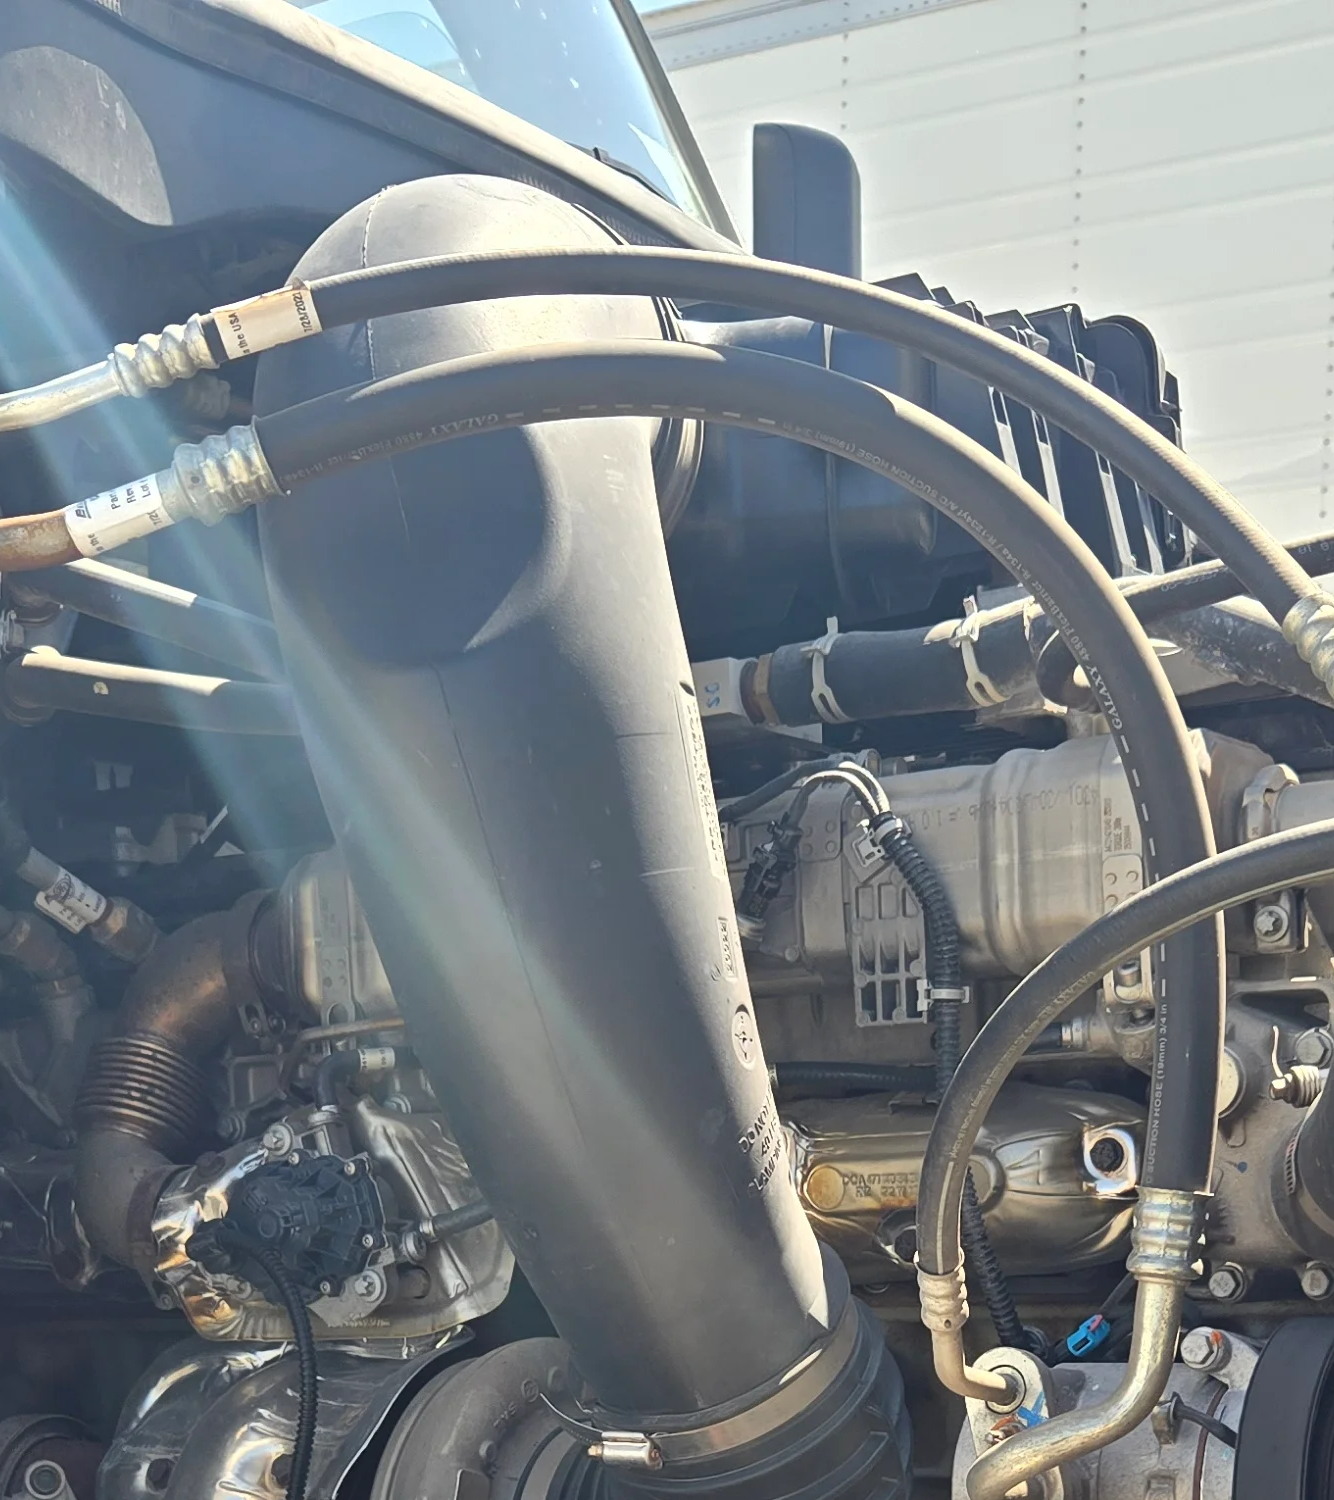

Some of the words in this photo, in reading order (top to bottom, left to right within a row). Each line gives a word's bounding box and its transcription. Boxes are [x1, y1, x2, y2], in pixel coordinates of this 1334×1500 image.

[228, 312, 242, 332] USA
[430, 413, 499, 438] GALAXY
[858, 448, 889, 469] HOSE
[891, 466, 940, 498] SUCTION
[939, 495, 958, 512] A/C
[1031, 580, 1071, 637] FlexBarrier
[1070, 635, 1090, 661] 4880
[1086, 664, 1123, 730] GALAXY
[1160, 1003, 1167, 1014] in
[1159, 1017, 1168, 1034] 3/4
[1157, 1036, 1168, 1080] (19mm)
[1154, 1083, 1164, 1118] HOSE
[1147, 1123, 1160, 1173] SUCTION
